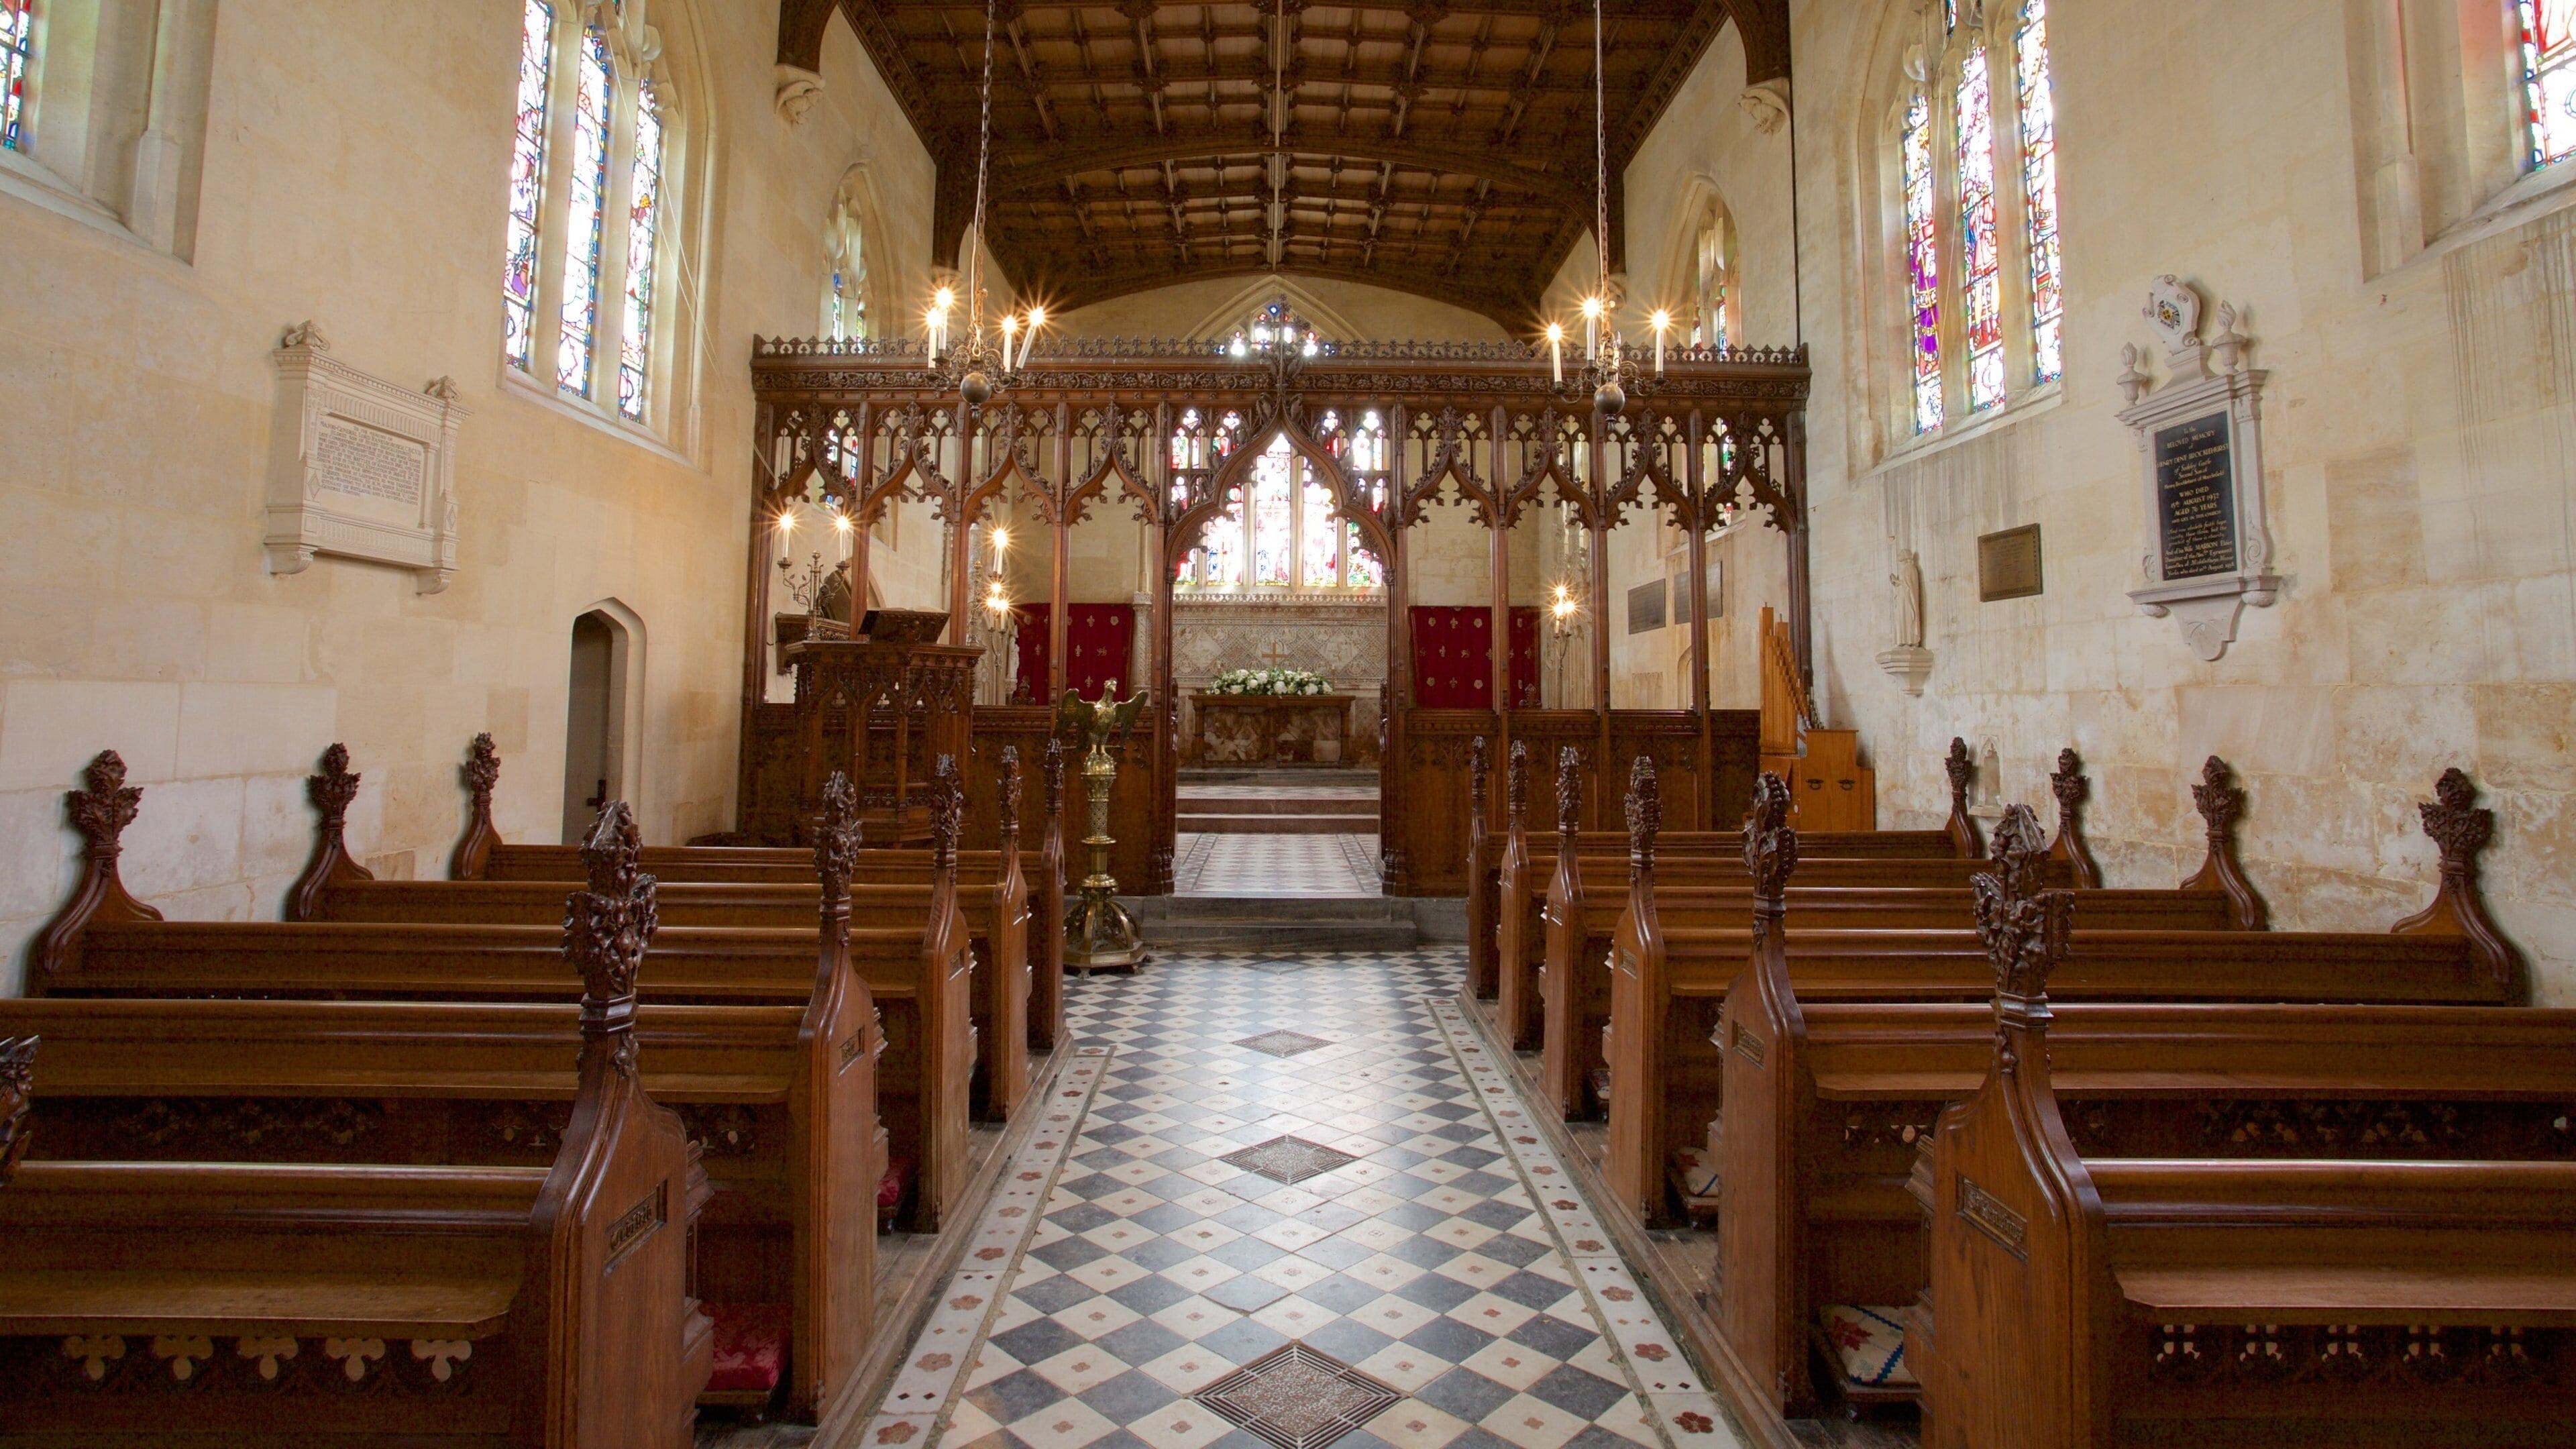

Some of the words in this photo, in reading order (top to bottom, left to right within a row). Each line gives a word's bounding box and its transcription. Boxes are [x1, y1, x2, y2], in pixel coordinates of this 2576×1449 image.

[2167, 437, 2188, 448] BELOVED
[2192, 429, 2214, 441] MEMORY
[2156, 459, 2171, 468] HENRY
[2183, 496, 2205, 505] AUGUST
[2200, 502, 2216, 510] YEARS
